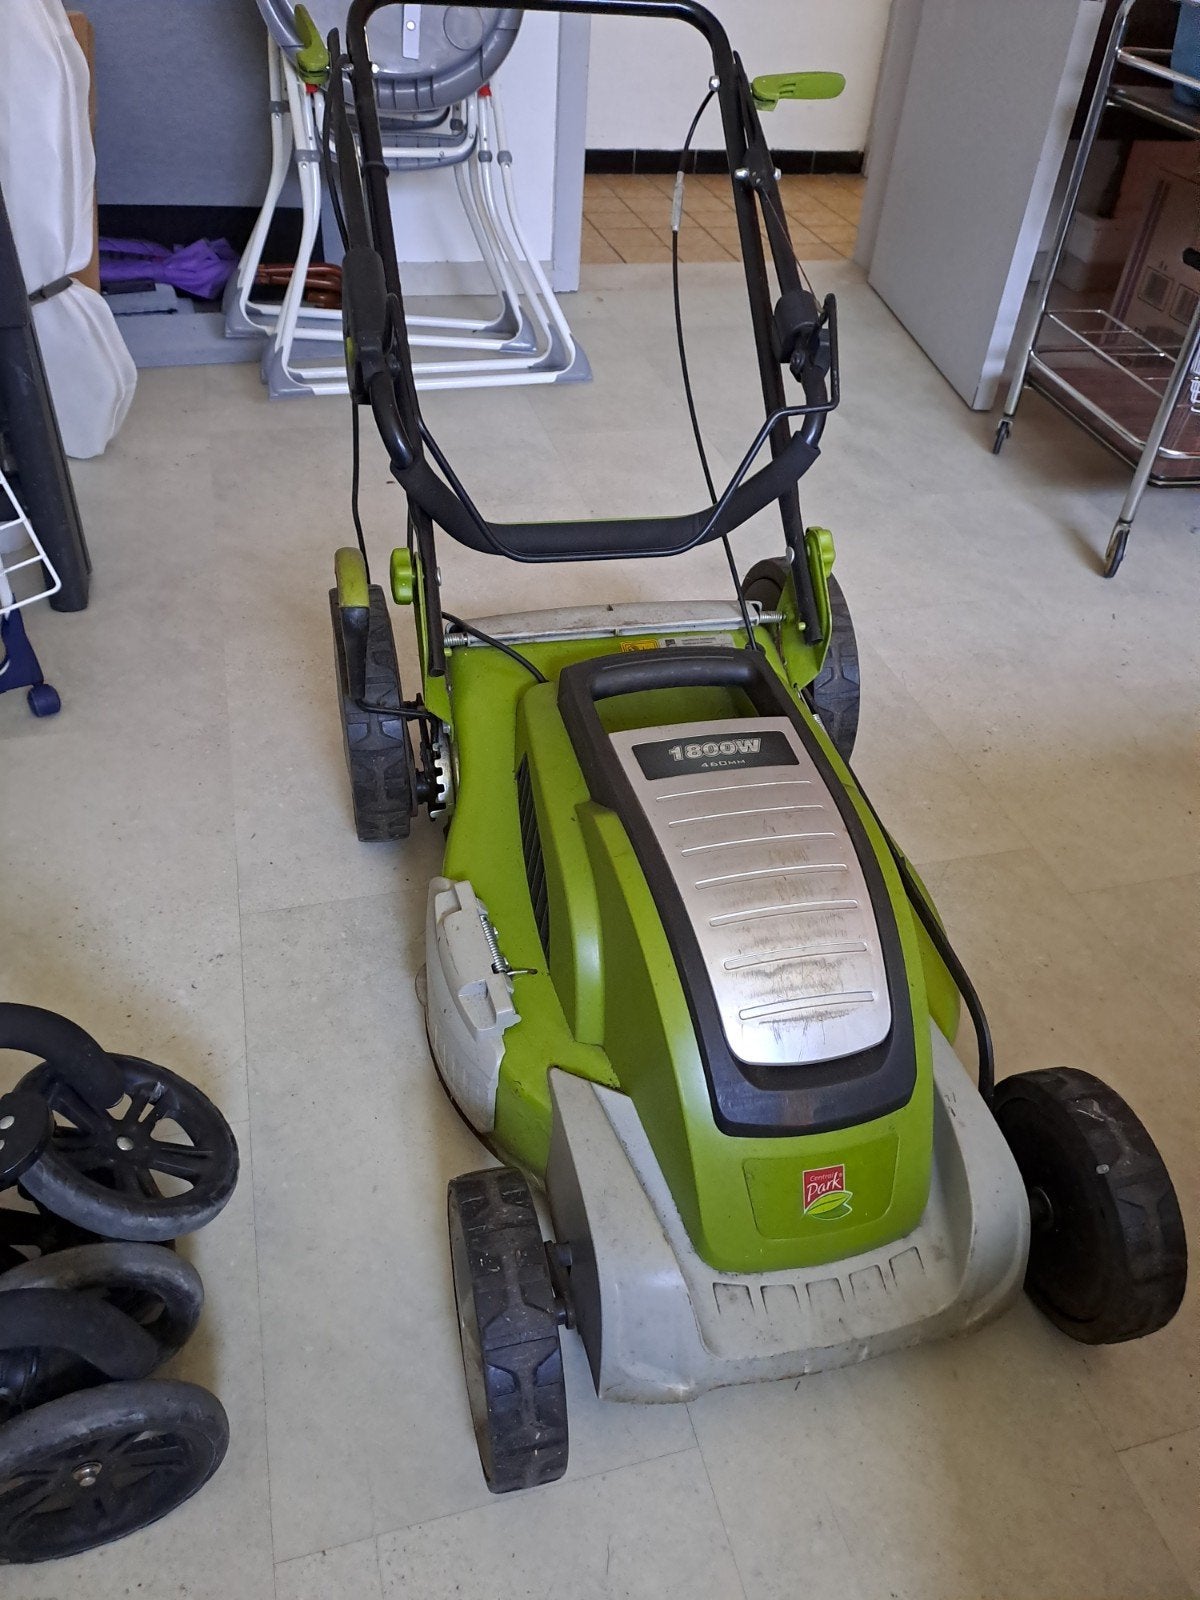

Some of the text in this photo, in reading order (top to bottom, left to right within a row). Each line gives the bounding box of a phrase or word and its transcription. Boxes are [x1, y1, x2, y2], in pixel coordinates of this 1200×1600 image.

[669, 738, 761, 761] 1800W
[807, 1172, 842, 1202] Park
[810, 1172, 835, 1182] Central
